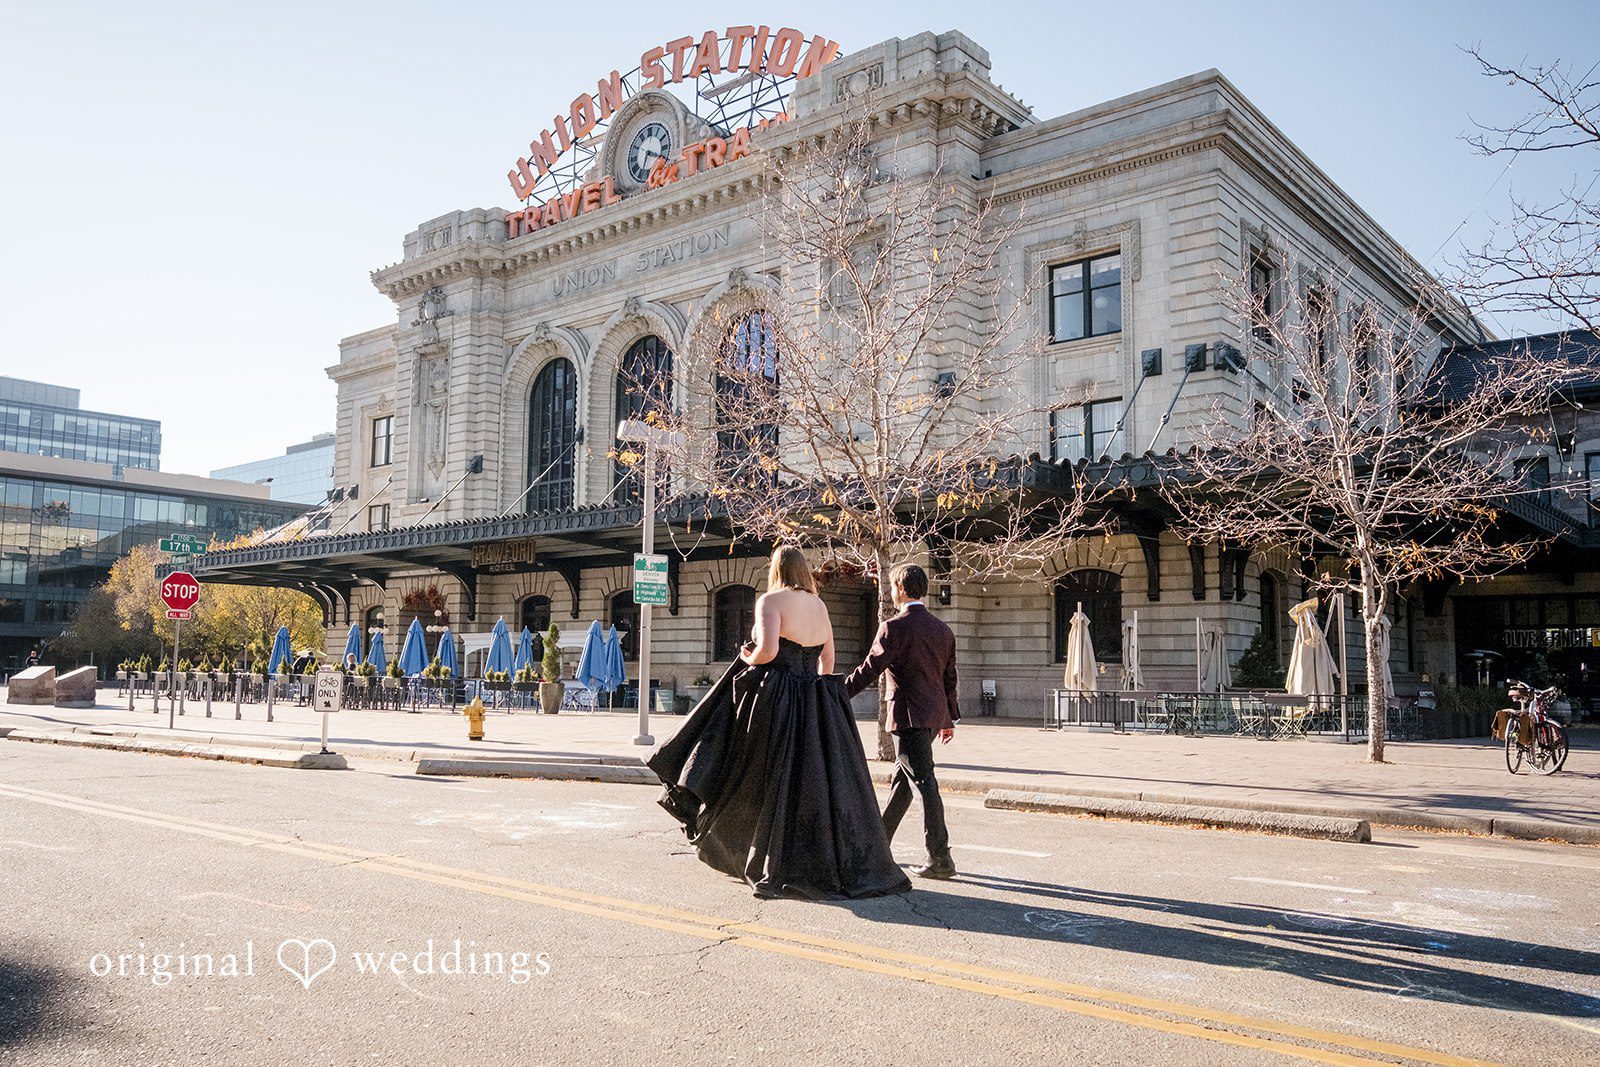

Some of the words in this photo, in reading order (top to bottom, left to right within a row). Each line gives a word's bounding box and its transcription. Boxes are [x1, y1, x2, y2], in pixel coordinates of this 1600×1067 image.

[507, 69, 624, 202] UNION
[640, 25, 840, 91] STATION
[504, 175, 623, 240] TRAVEL
[551, 260, 617, 298] UNION
[636, 224, 731, 272] STATION
[170, 541, 191, 553] 17th
[163, 582, 198, 599] STOP
[1503, 629, 1538, 648] OLIVE
[1552, 629, 1589, 648] FINCH
[318, 689, 337, 698] ONLY
